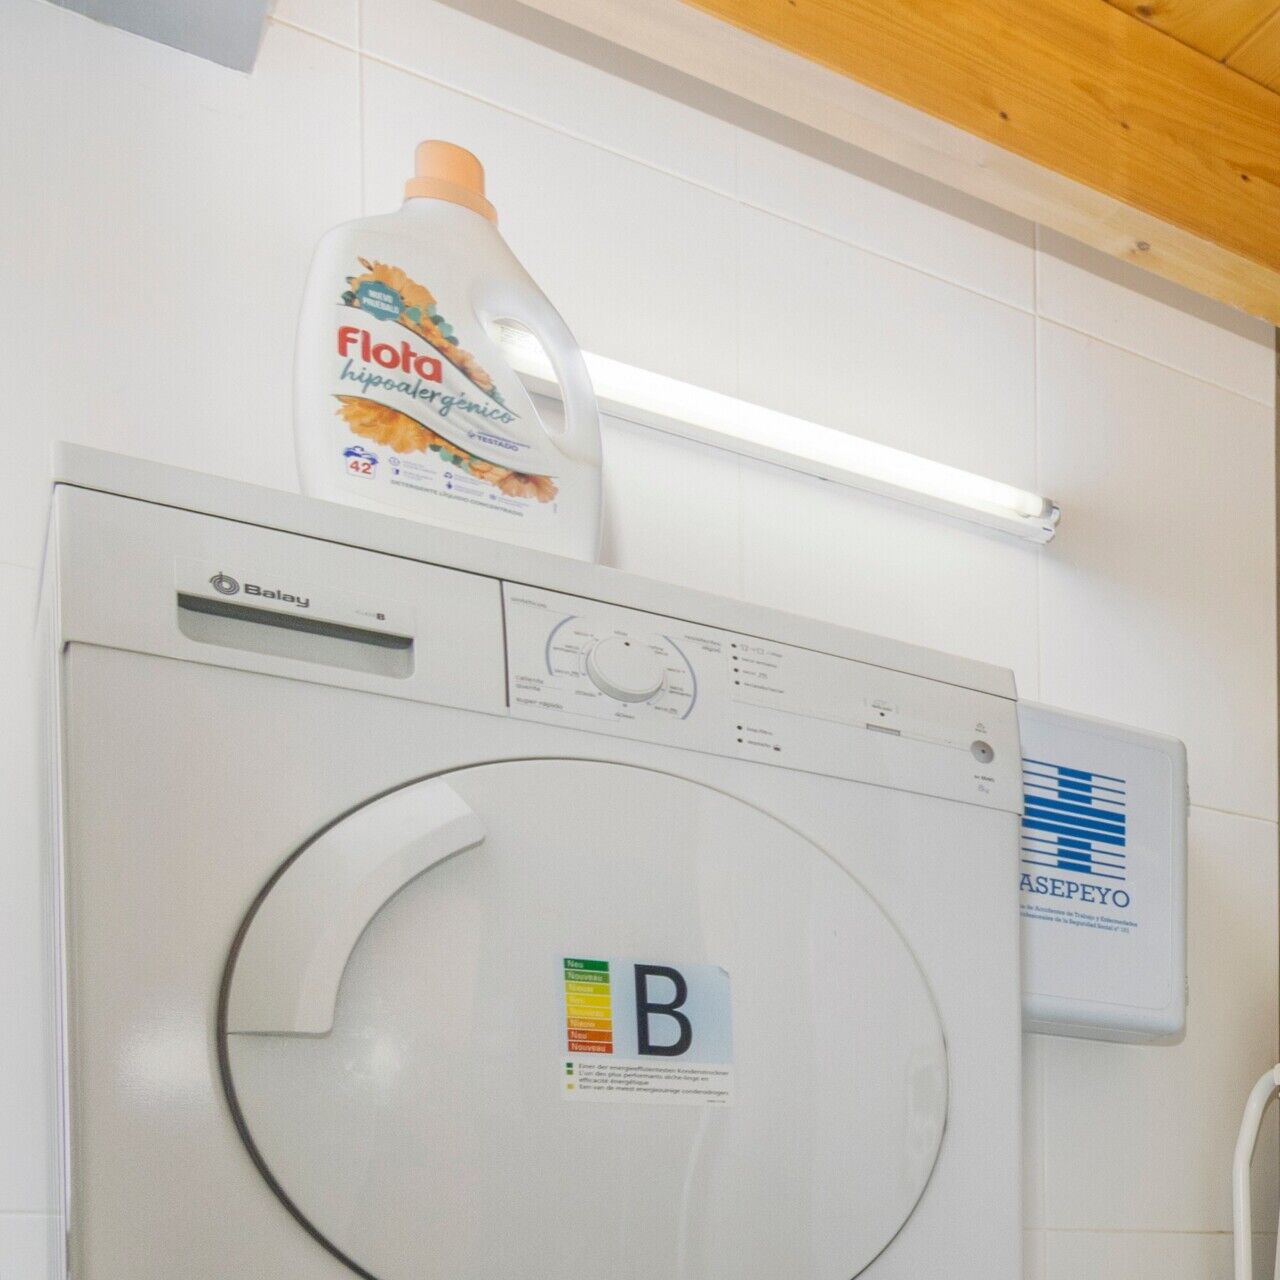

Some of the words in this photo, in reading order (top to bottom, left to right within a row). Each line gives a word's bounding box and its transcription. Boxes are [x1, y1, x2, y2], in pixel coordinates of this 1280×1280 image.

[337, 326, 443, 384] Flota
[340, 359, 516, 424] hipoalergénico
[478, 436, 519, 452] TESTADO
[349, 460, 372, 475] 42
[244, 583, 311, 608] Balay
[1019, 873, 1130, 908] ASEPEYO
[634, 963, 693, 1057] B
